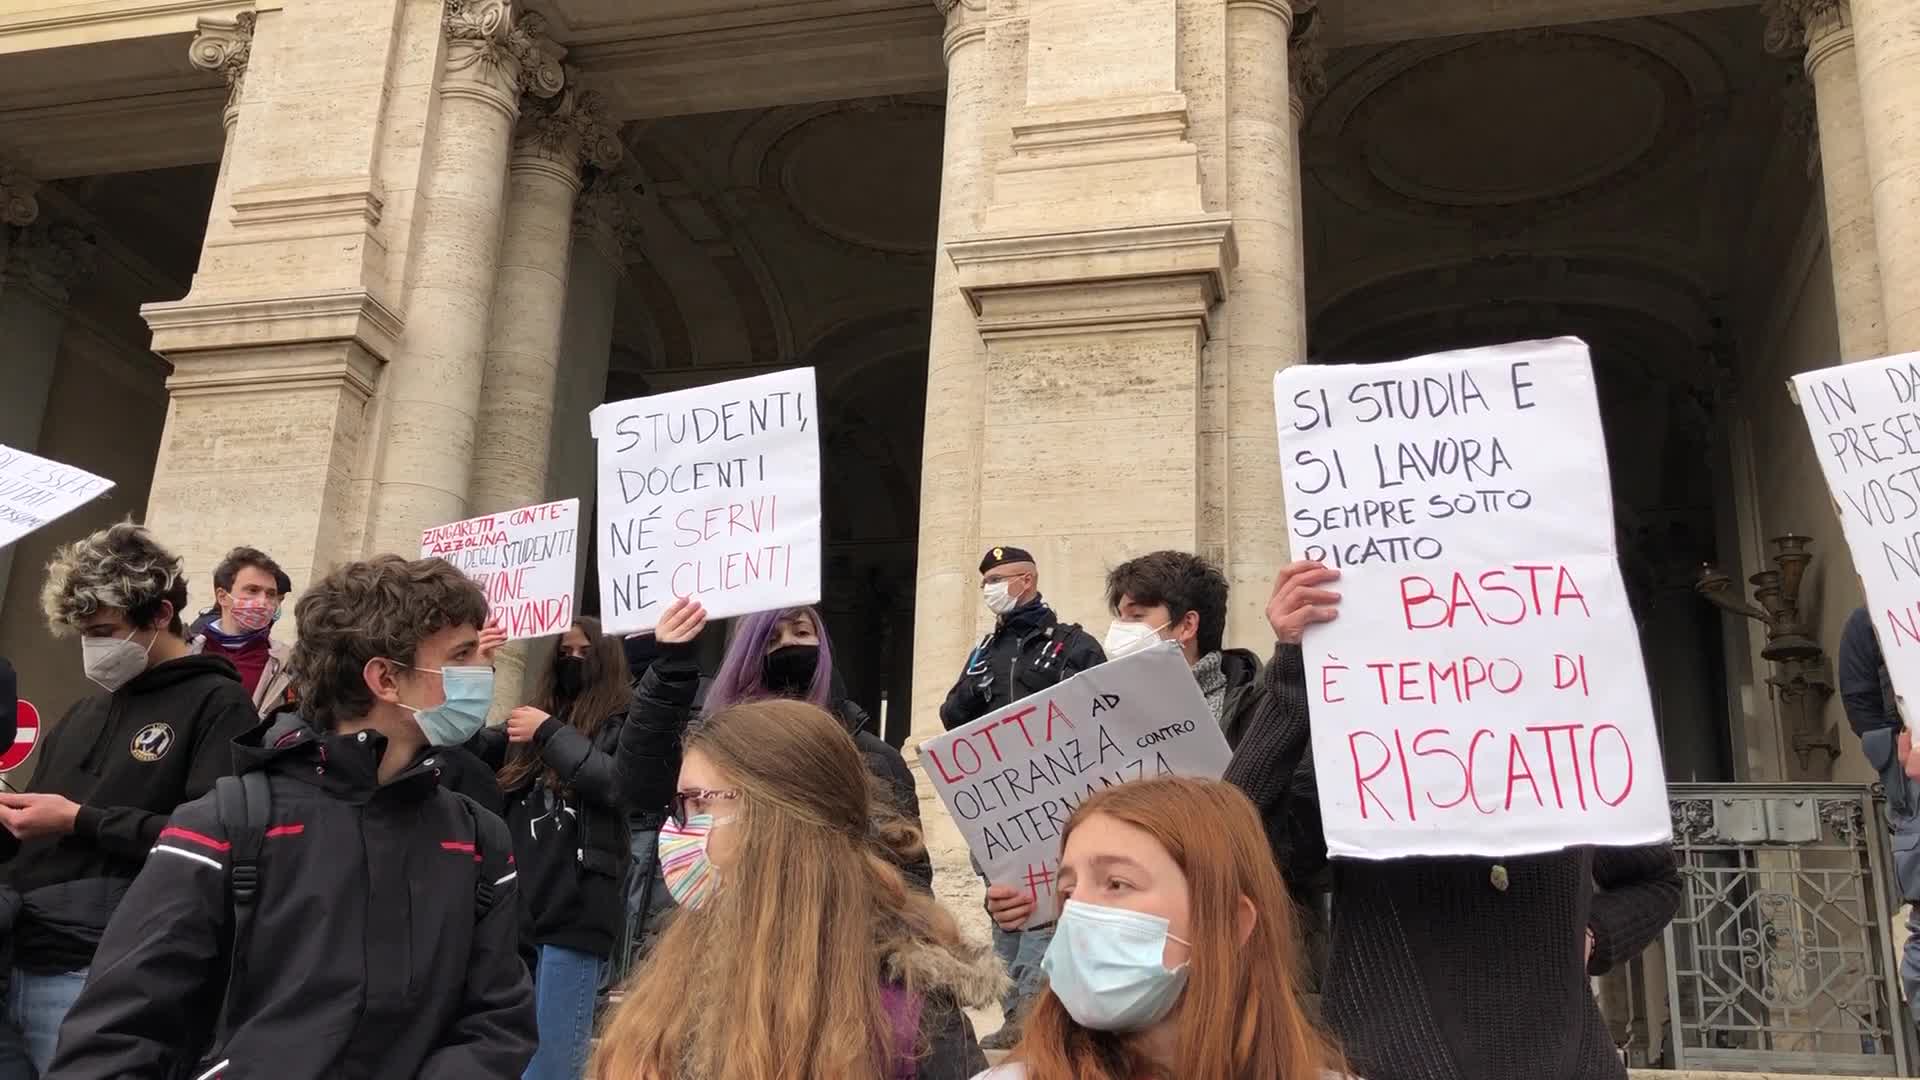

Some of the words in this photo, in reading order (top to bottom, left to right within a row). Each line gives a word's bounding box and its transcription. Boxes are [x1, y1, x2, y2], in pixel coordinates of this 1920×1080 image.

[615, 391, 808, 454] STUDENTI,
[1293, 388, 1332, 431] SI
[1348, 368, 1490, 423] STUDIA
[1510, 361, 1536, 411] E
[1809, 377, 1857, 425] IN
[616, 454, 764, 505] DOCENTI
[1294, 449, 1348, 494] SI
[1373, 437, 1513, 489] LAVORA
[422, 518, 495, 546] ZINGARETTI
[431, 530, 509, 554] AZZOLINA
[610, 504, 663, 558] NÉ
[673, 495, 777, 548] SERVI
[1293, 497, 1416, 539] SEMPRE
[1428, 488, 1533, 519] SOTTO
[463, 544, 498, 570] DEGLI
[501, 528, 575, 569] STUDENTI
[612, 559, 659, 616] NÉ
[671, 543, 791, 601] CLIENTI
[1399, 565, 1591, 631] BASTA
[490, 593, 570, 637] RIVANDO
[1322, 653, 1350, 704] È
[1365, 655, 1523, 705] TEMPO
[1552, 653, 1589, 697] DI
[927, 699, 1075, 785] LOTTA
[1091, 693, 1121, 718] AD
[953, 723, 1125, 821] OLTRANZA
[1136, 719, 1196, 749] CONTRO
[1347, 723, 1634, 822] RISCATTO
